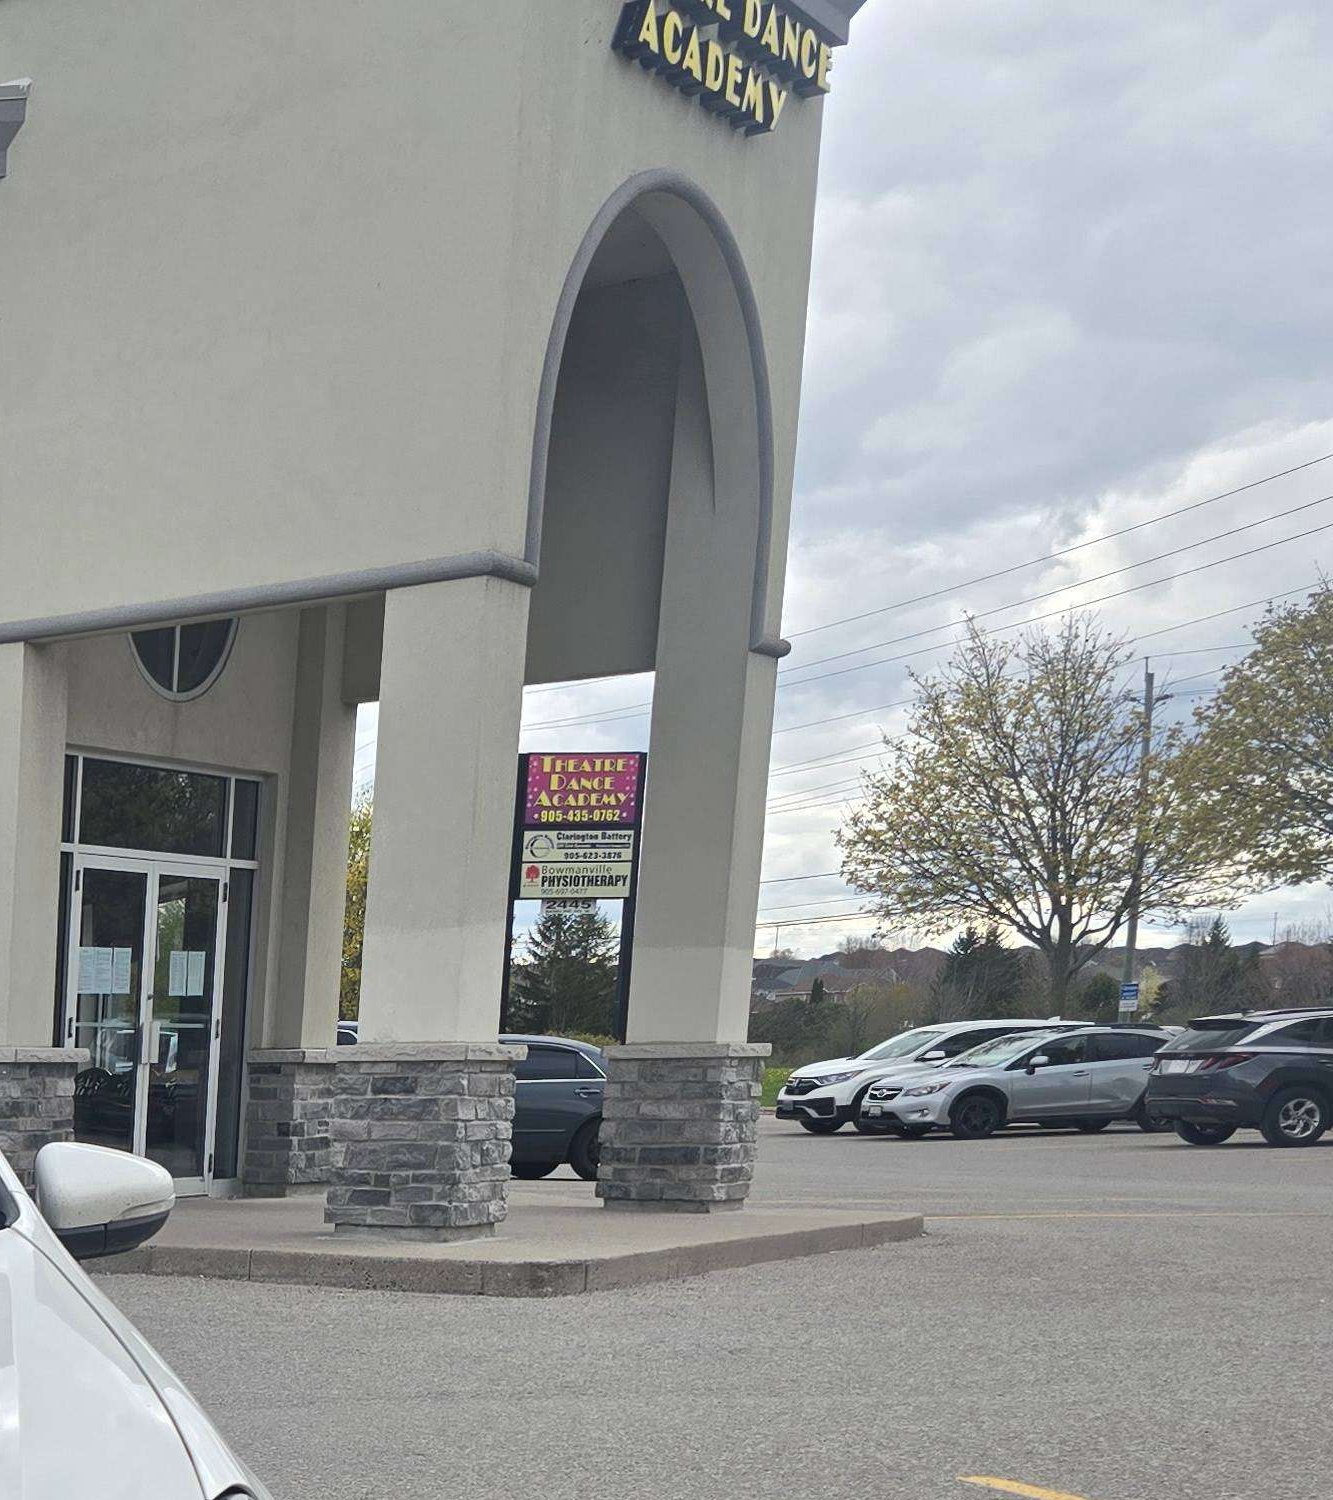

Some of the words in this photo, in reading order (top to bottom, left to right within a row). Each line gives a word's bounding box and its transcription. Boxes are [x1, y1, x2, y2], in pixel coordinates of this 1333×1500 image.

[743, 0, 833, 93] DANCE
[638, 0, 789, 131] ACADEMY
[541, 756, 627, 773] THEATRE
[550, 774, 615, 791] DANCE
[533, 790, 630, 807] ACADEMY
[540, 809, 621, 822] 905-435-0762
[556, 832, 599, 841] Clarington
[601, 832, 632, 841] Battery
[541, 865, 613, 874] Bowmanville
[541, 875, 629, 887] PHYSIOTHERAPY
[546, 900, 592, 909] 2445
